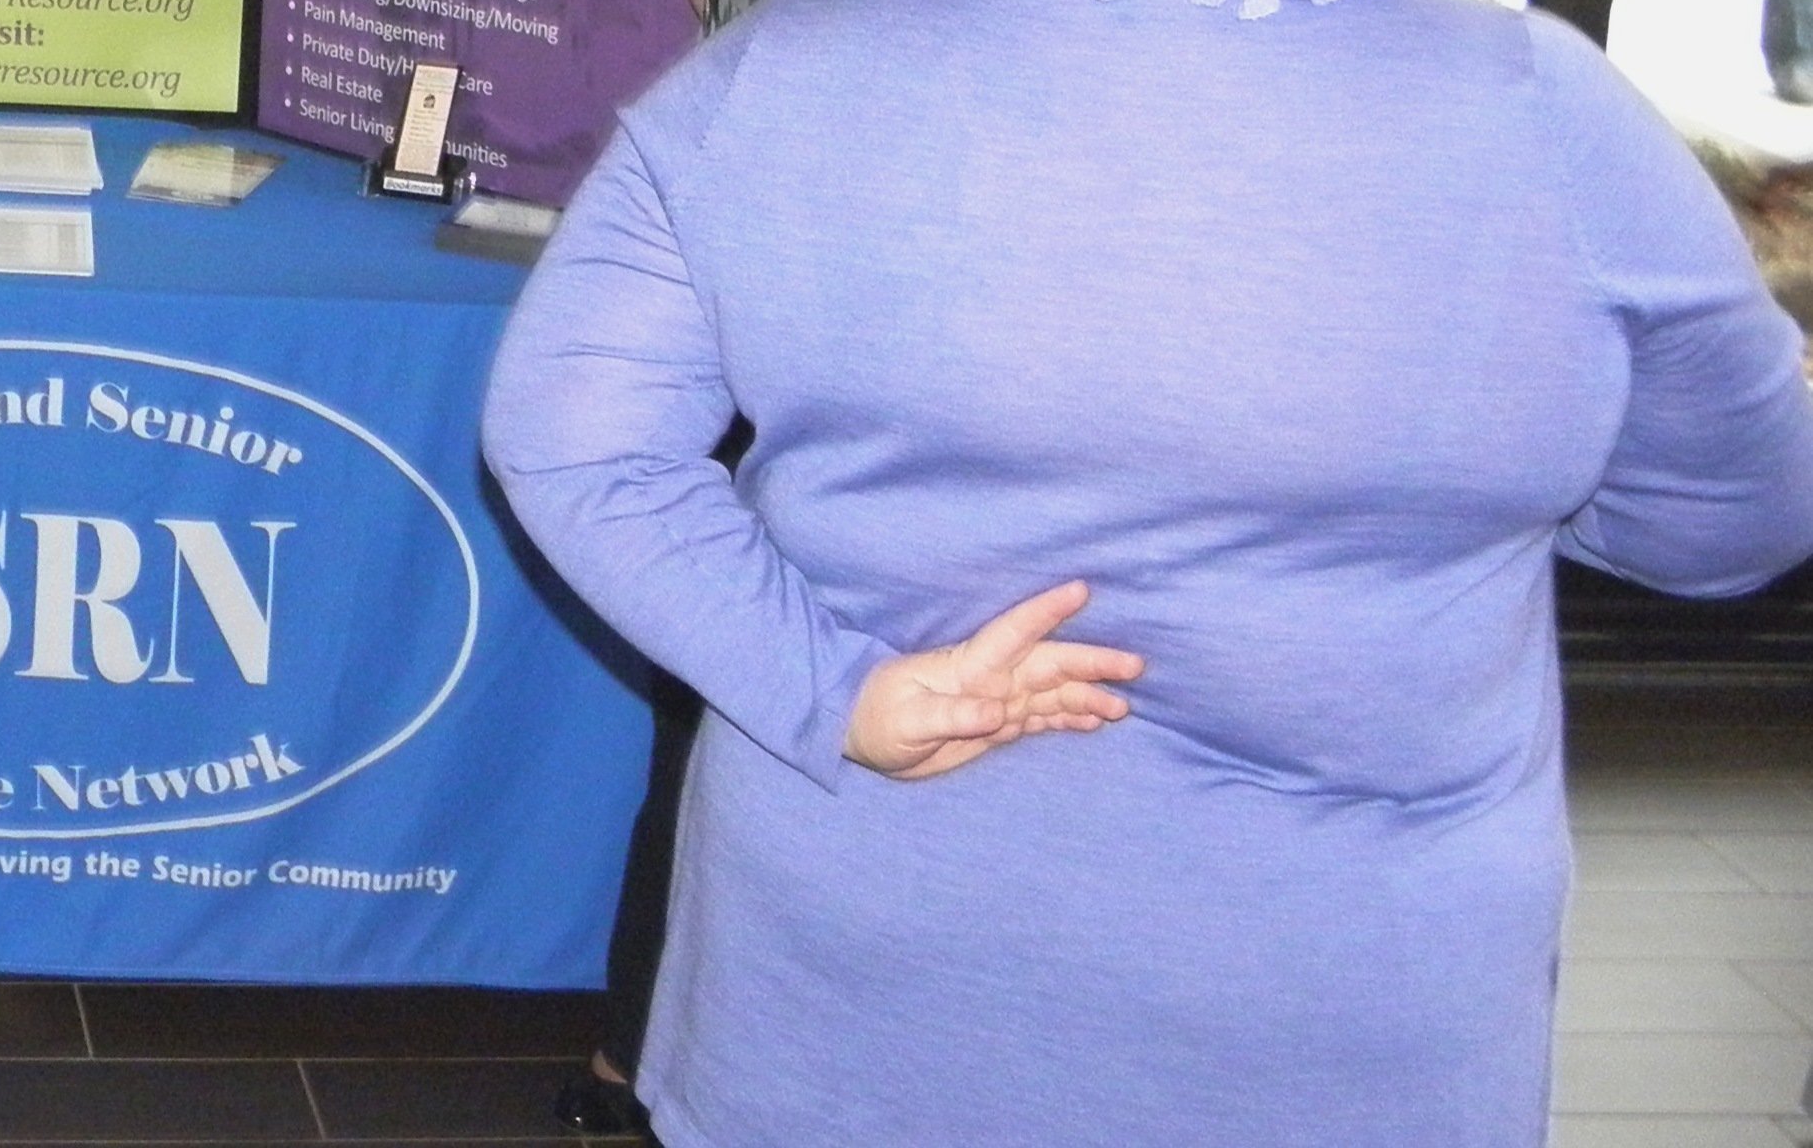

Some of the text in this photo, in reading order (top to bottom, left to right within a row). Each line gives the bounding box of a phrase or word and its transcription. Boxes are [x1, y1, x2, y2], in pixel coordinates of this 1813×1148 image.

[303, 32, 354, 58] Private
[304, 0, 446, 47] Pain Management
[301, 66, 383, 101] Real Estate
[300, 99, 347, 125] Senior
[351, 113, 395, 147] Living
[86, 382, 304, 476] Senior
[34, 734, 307, 813] Network
[83, 851, 142, 880] the
[152, 854, 258, 887] Senior
[268, 858, 458, 895] Community
